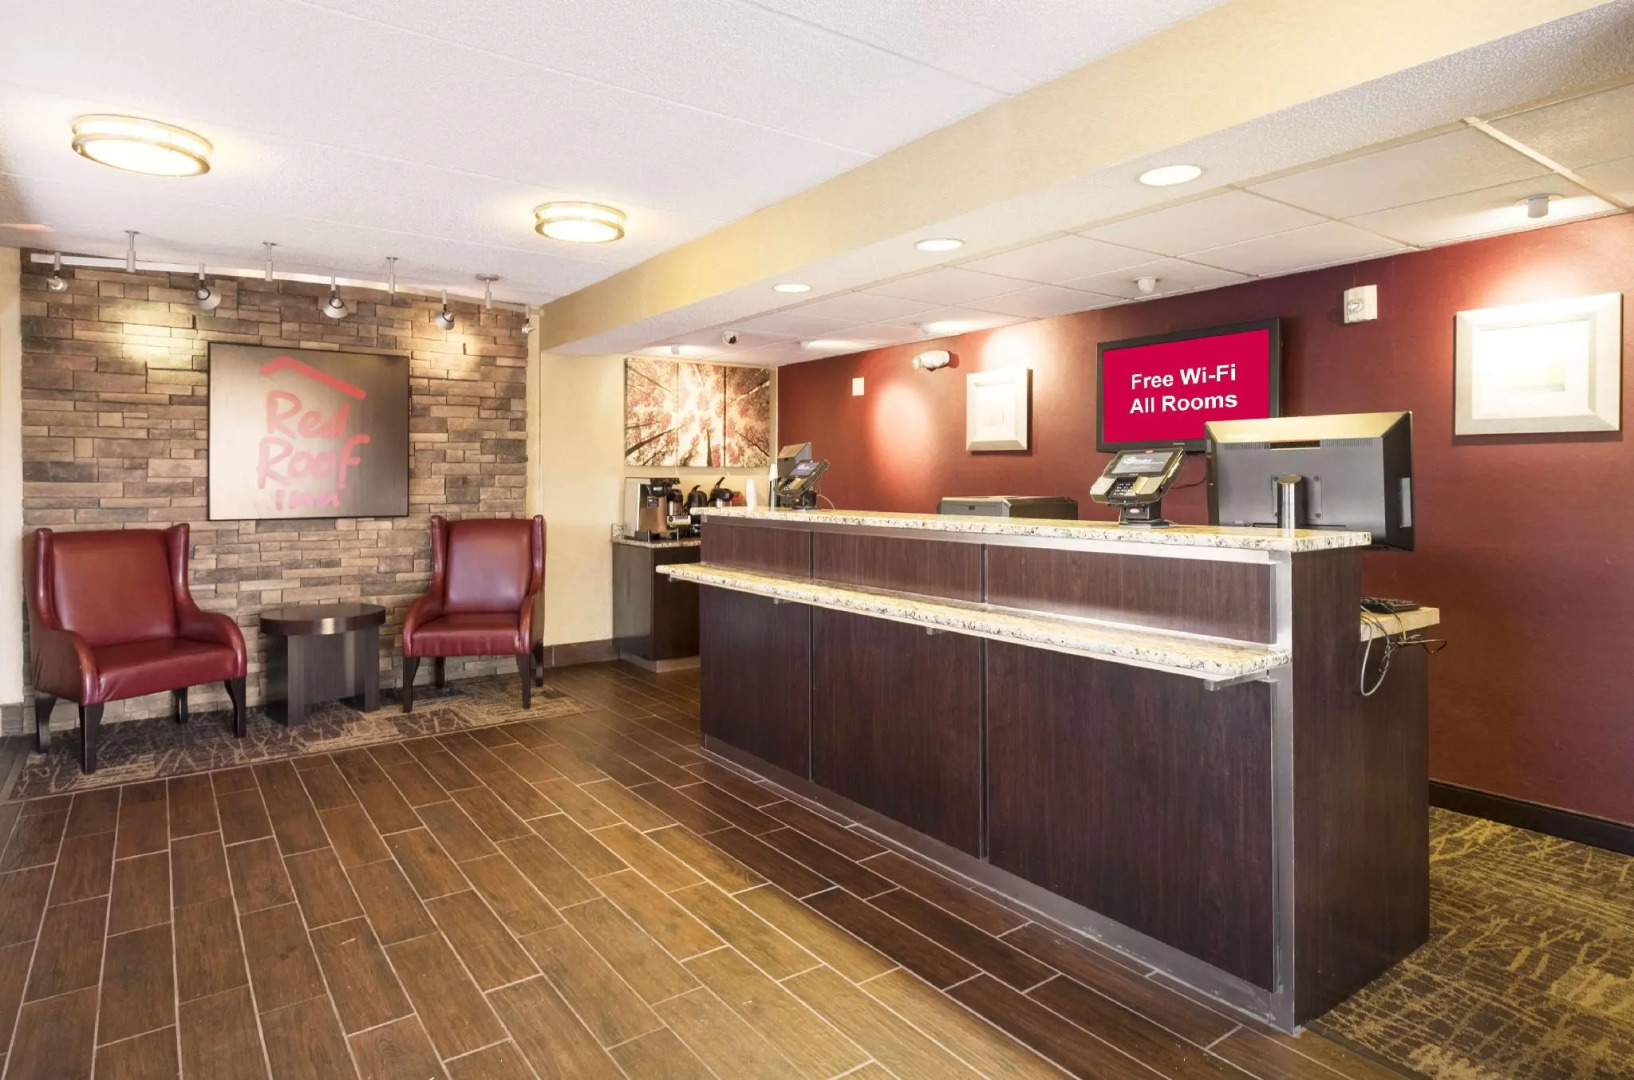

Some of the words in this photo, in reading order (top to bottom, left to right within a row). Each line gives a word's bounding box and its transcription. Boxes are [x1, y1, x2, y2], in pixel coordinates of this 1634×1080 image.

[1132, 374, 1173, 390] Free
[1180, 364, 1236, 385] Wi-Fi
[267, 391, 349, 439] Red
[1130, 397, 1155, 414] All
[1162, 394, 1237, 412] Rooms
[257, 435, 370, 489] Roof
